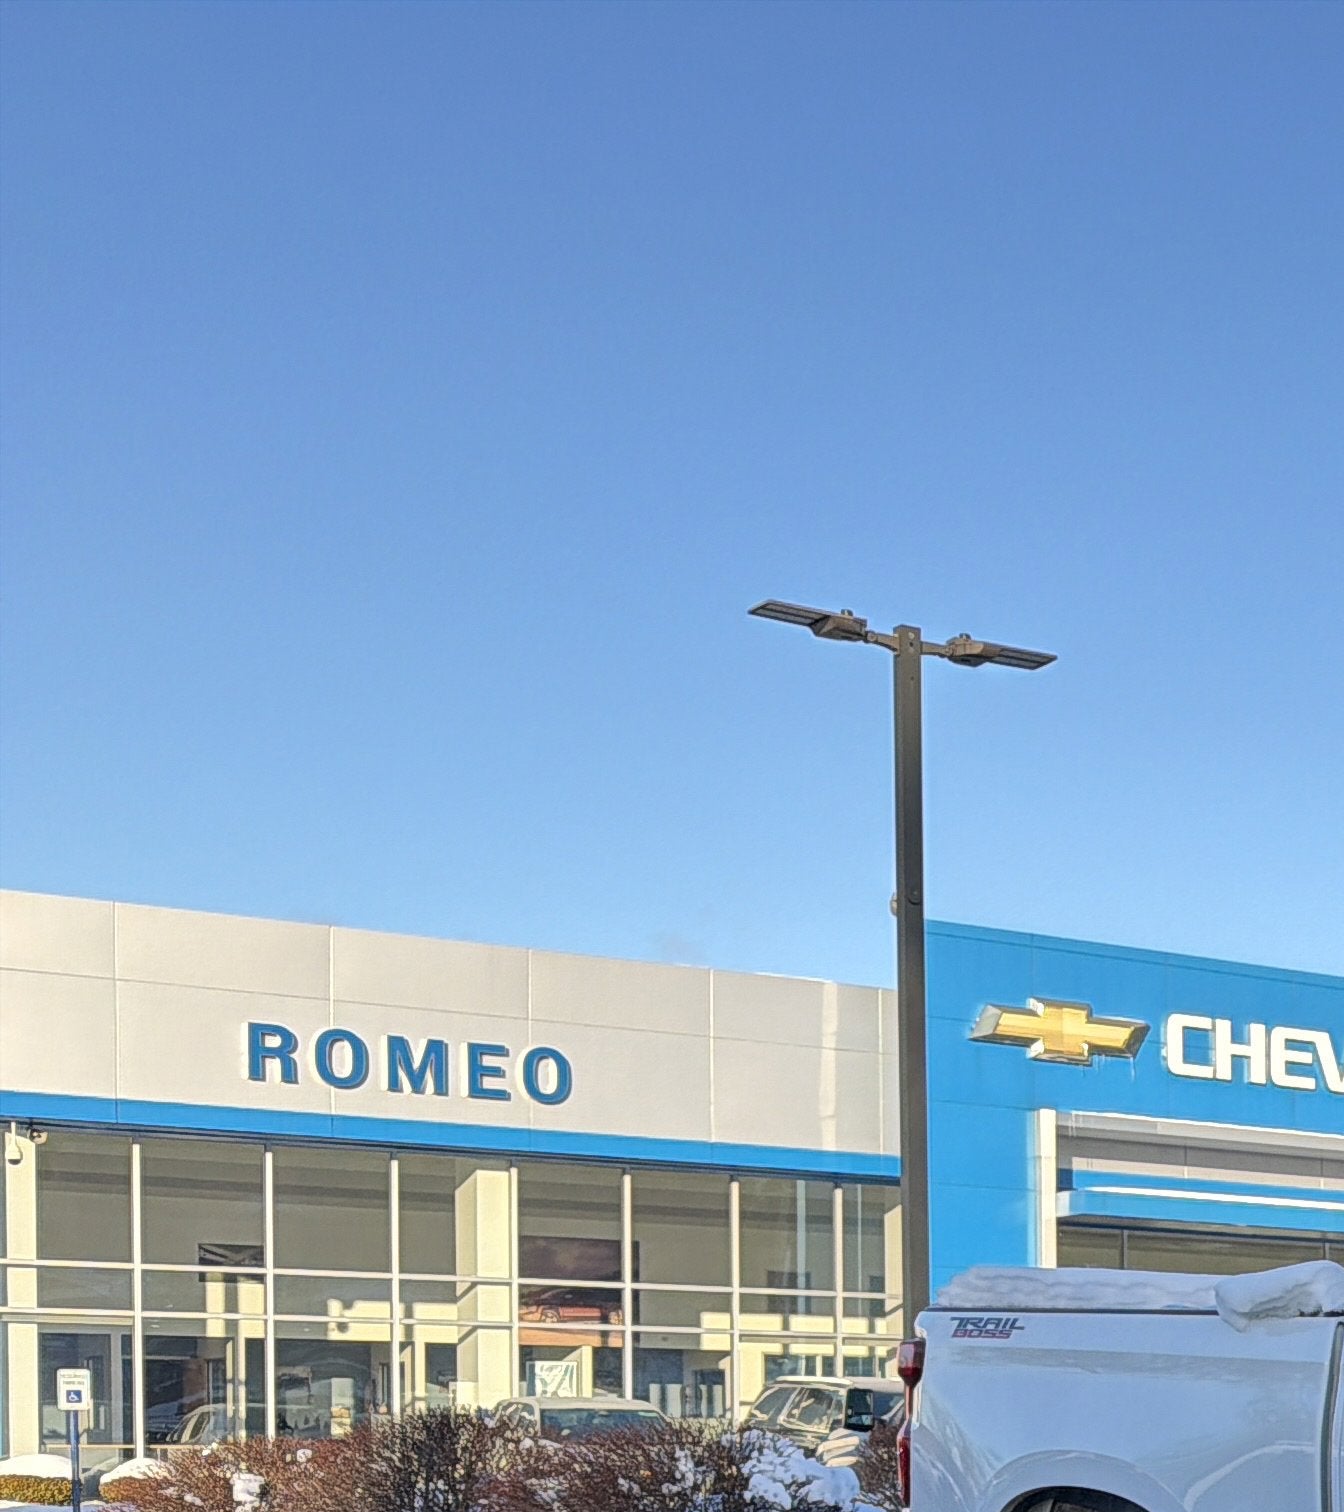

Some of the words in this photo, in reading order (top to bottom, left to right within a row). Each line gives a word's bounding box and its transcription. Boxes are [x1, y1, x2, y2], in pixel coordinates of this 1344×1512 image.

[243, 1021, 573, 1106] ROMEO
[949, 1316, 1025, 1330] TRAIL
[951, 1328, 1013, 1339] BOSS
